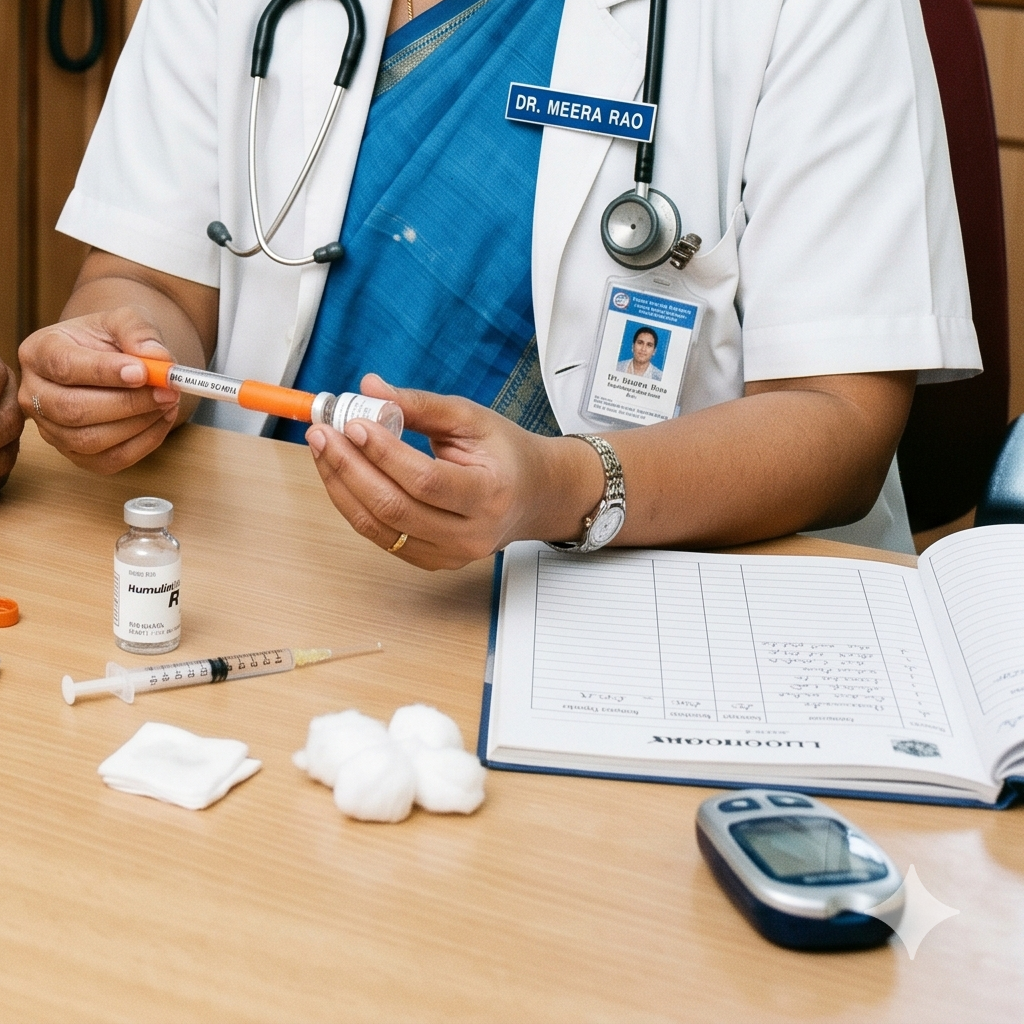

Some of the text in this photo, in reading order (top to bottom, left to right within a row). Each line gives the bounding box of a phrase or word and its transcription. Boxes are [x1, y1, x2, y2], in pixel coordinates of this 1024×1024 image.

[515, 94, 644, 130] DR. MEERA RAO
[168, 589, 180, 608] R
